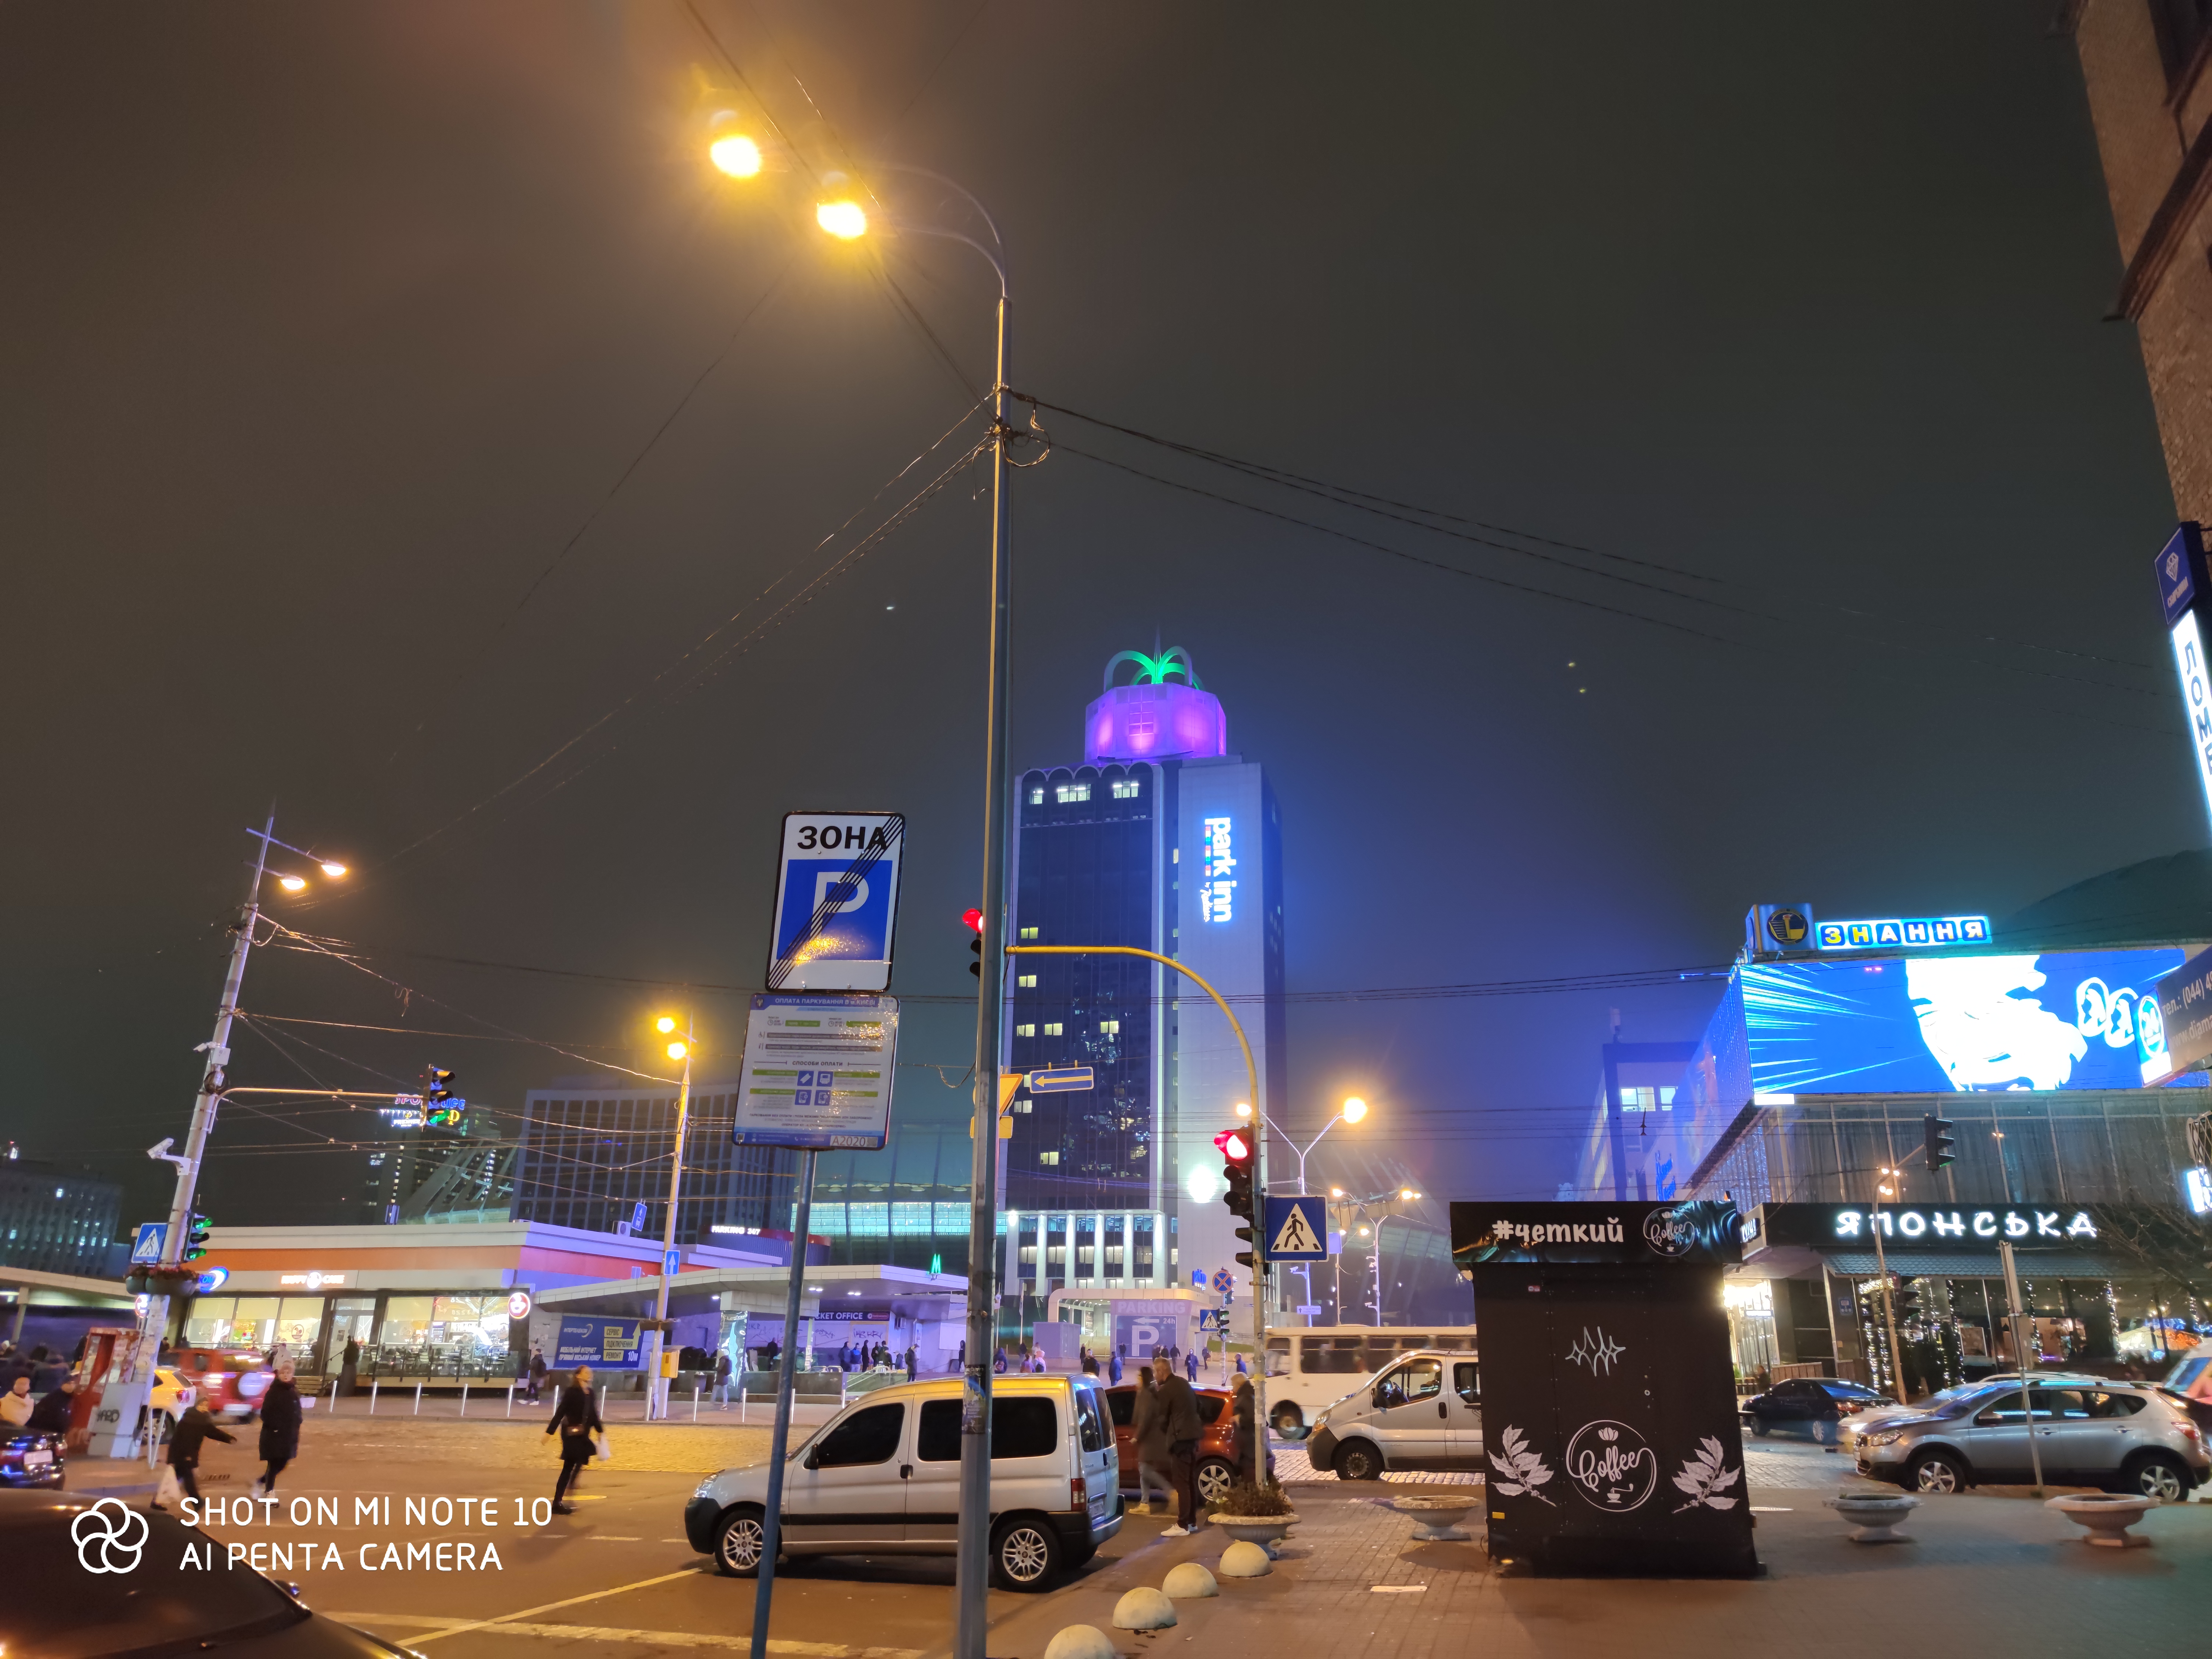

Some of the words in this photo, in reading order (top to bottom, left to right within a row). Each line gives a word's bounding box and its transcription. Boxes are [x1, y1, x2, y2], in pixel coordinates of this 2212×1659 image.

[797, 826, 887, 850] ЗОНА
[1205, 817, 1237, 877] park
[1214, 880, 1237, 922] inn
[1824, 920, 1984, 944] ЗНАННЯ
[2162, 996, 2181, 1017] тел.:
[2183, 978, 2205, 1010] (044)
[832, 1136, 866, 1146] A2020
[711, 1225, 745, 1235] PARKING
[1491, 1217, 1624, 1244] #четкий
[1650, 1221, 1688, 1247] Coffee
[1837, 1211, 2097, 1238] ЯПОНСЬКА
[1117, 1301, 1185, 1314] PARKING
[1132, 1325, 1159, 1357] P
[1579, 1446, 1640, 1492] Coffee
